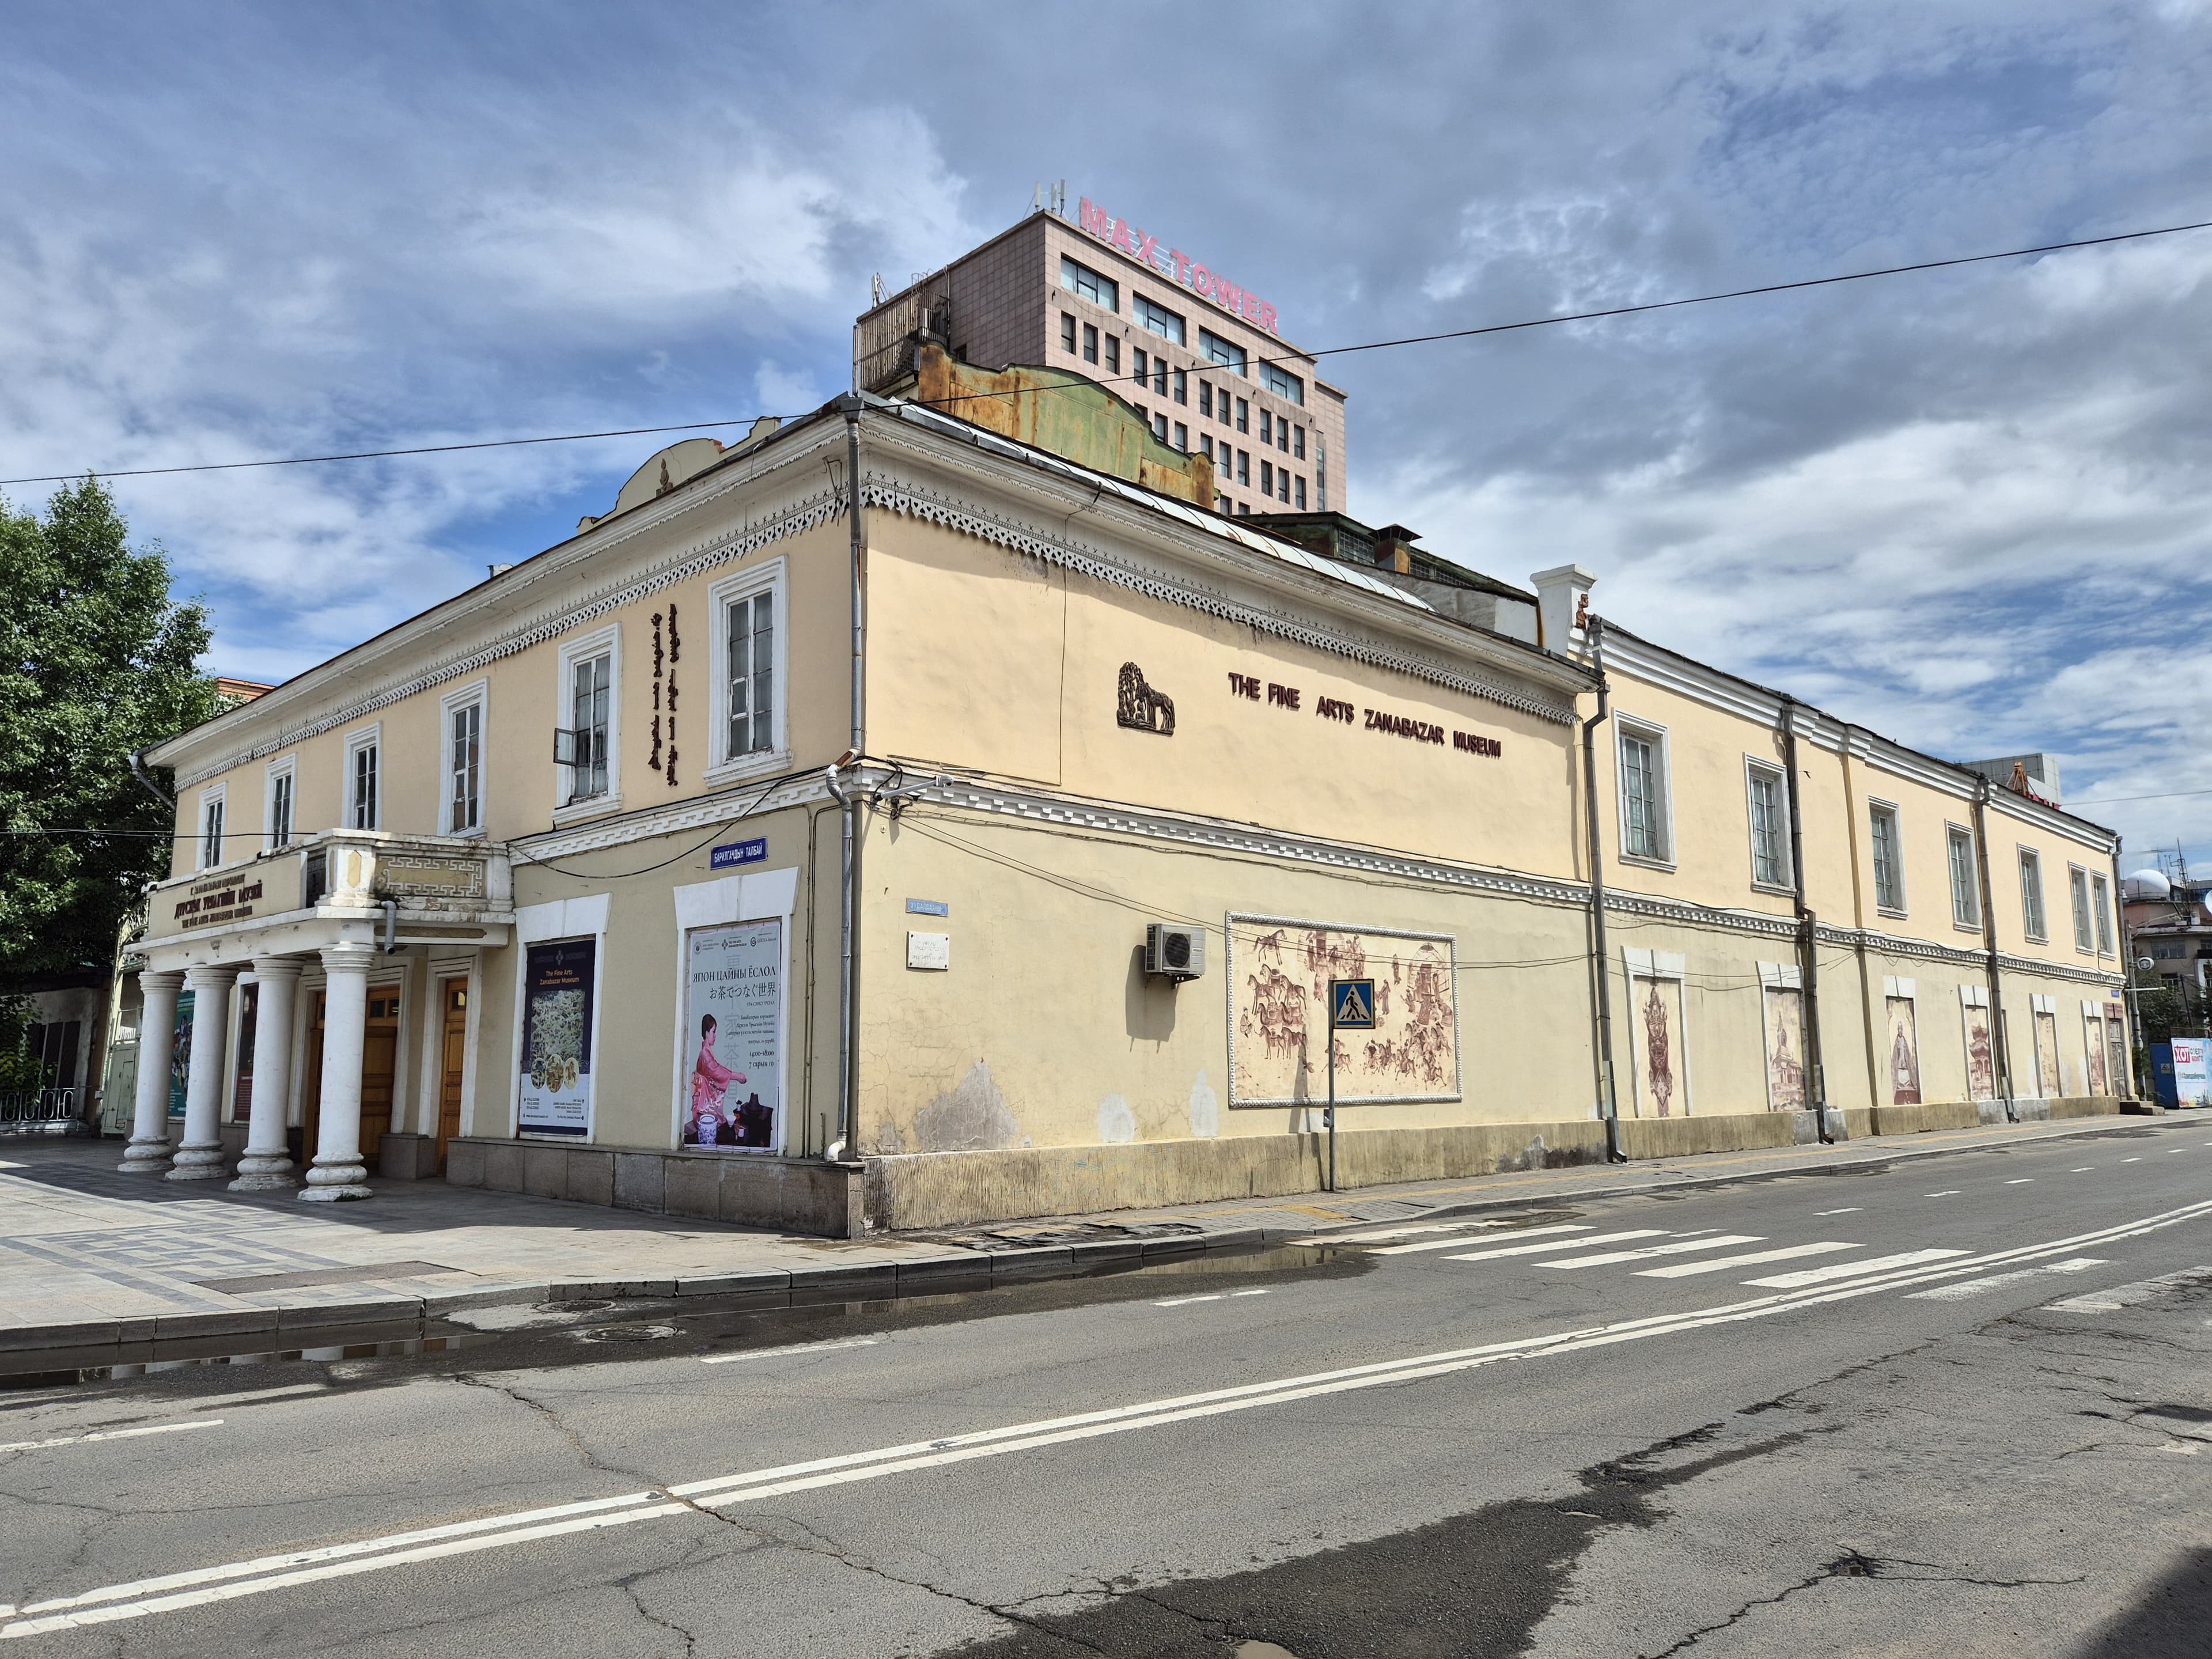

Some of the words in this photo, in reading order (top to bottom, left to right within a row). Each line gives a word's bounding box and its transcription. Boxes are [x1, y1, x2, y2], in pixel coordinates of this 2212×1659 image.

[1080, 196, 1159, 271] MAX
[1171, 248, 1278, 336] TOWER
[1228, 672, 1261, 699] THE
[1268, 683, 1301, 709] FINE
[1316, 696, 1355, 722] ARTS
[1364, 709, 1445, 745] ZANABAZAR
[1453, 730, 1502, 757] MUSEUM
[745, 842, 763, 857] ТАЛБАЙ
[693, 971, 715, 983] ЯПОН
[717, 967, 747, 981] ЦАЙНЫ
[749, 965, 776, 978] ЁСЛОЛ
[709, 982, 776, 1001] お茶でつなぐ世界
[749, 1062, 752, 1070] 7
[752, 1061, 768, 1070] сарын
